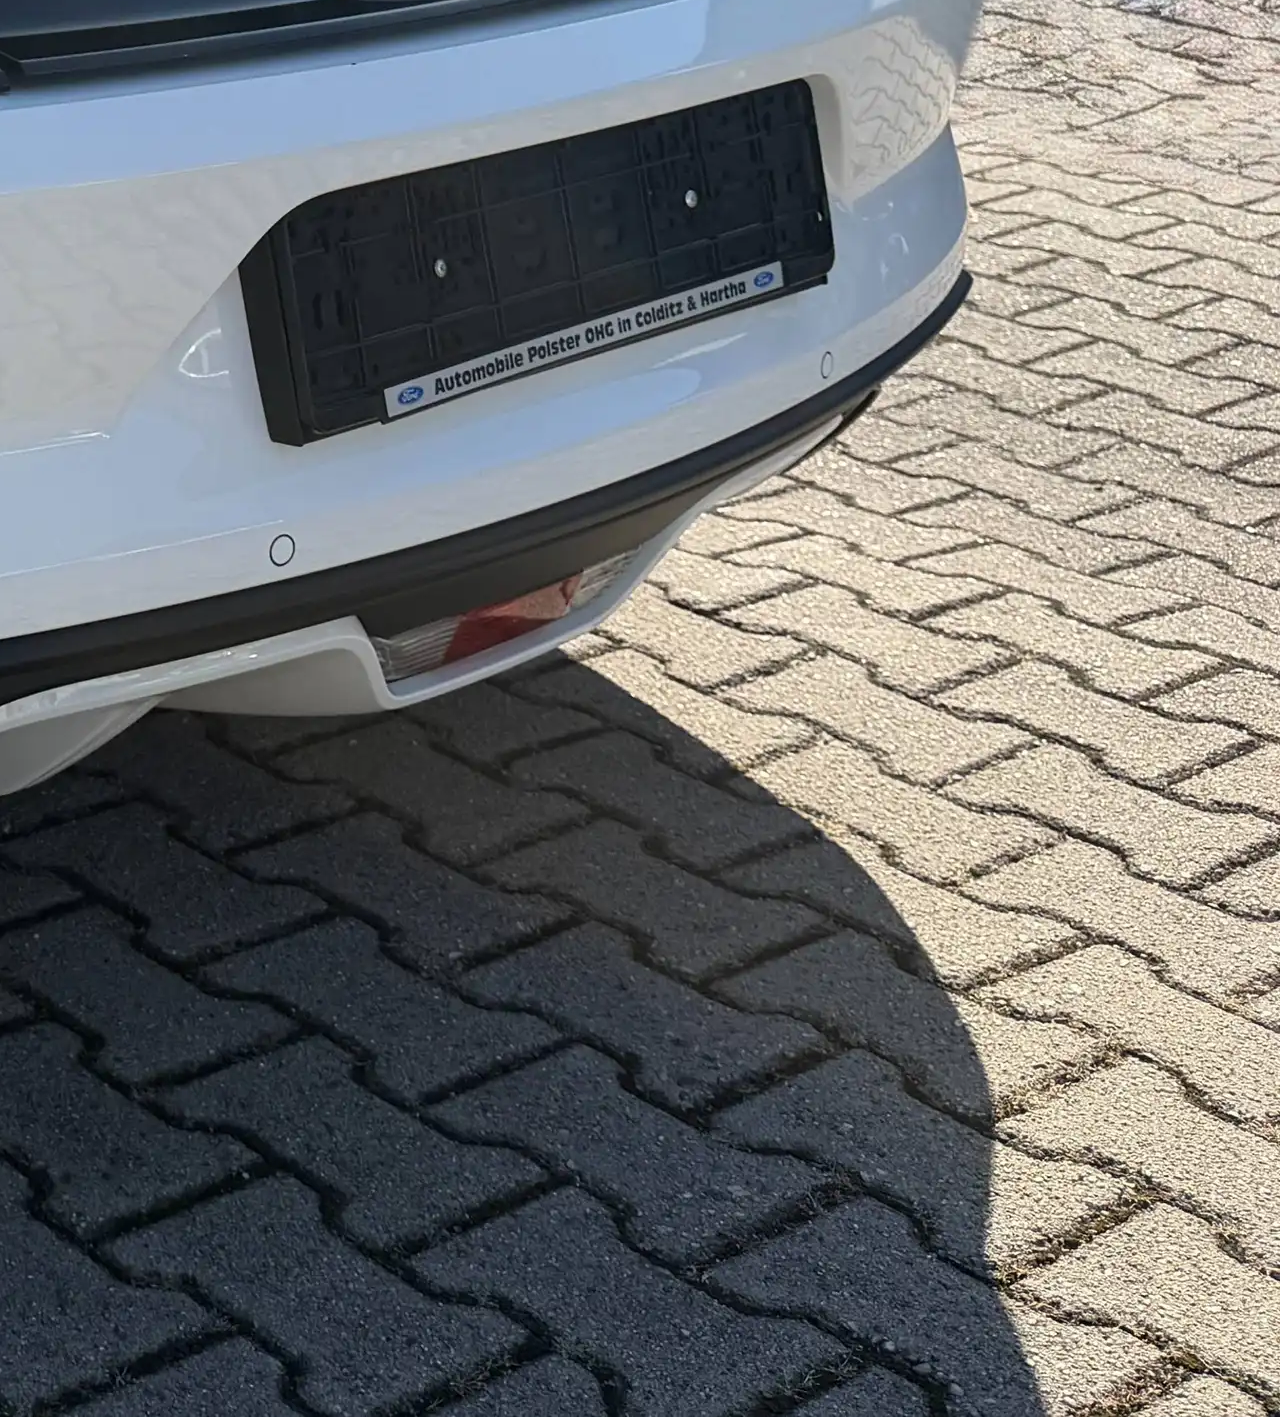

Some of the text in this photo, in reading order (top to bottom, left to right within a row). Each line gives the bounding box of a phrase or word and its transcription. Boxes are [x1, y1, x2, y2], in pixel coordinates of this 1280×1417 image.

[434, 352, 523, 395] Automobile
[527, 334, 581, 363] Polster
[585, 321, 614, 344] OHG
[618, 317, 631, 333] in
[635, 301, 683, 328] Colditz
[687, 296, 697, 311] &
[700, 281, 746, 307] Hartha
